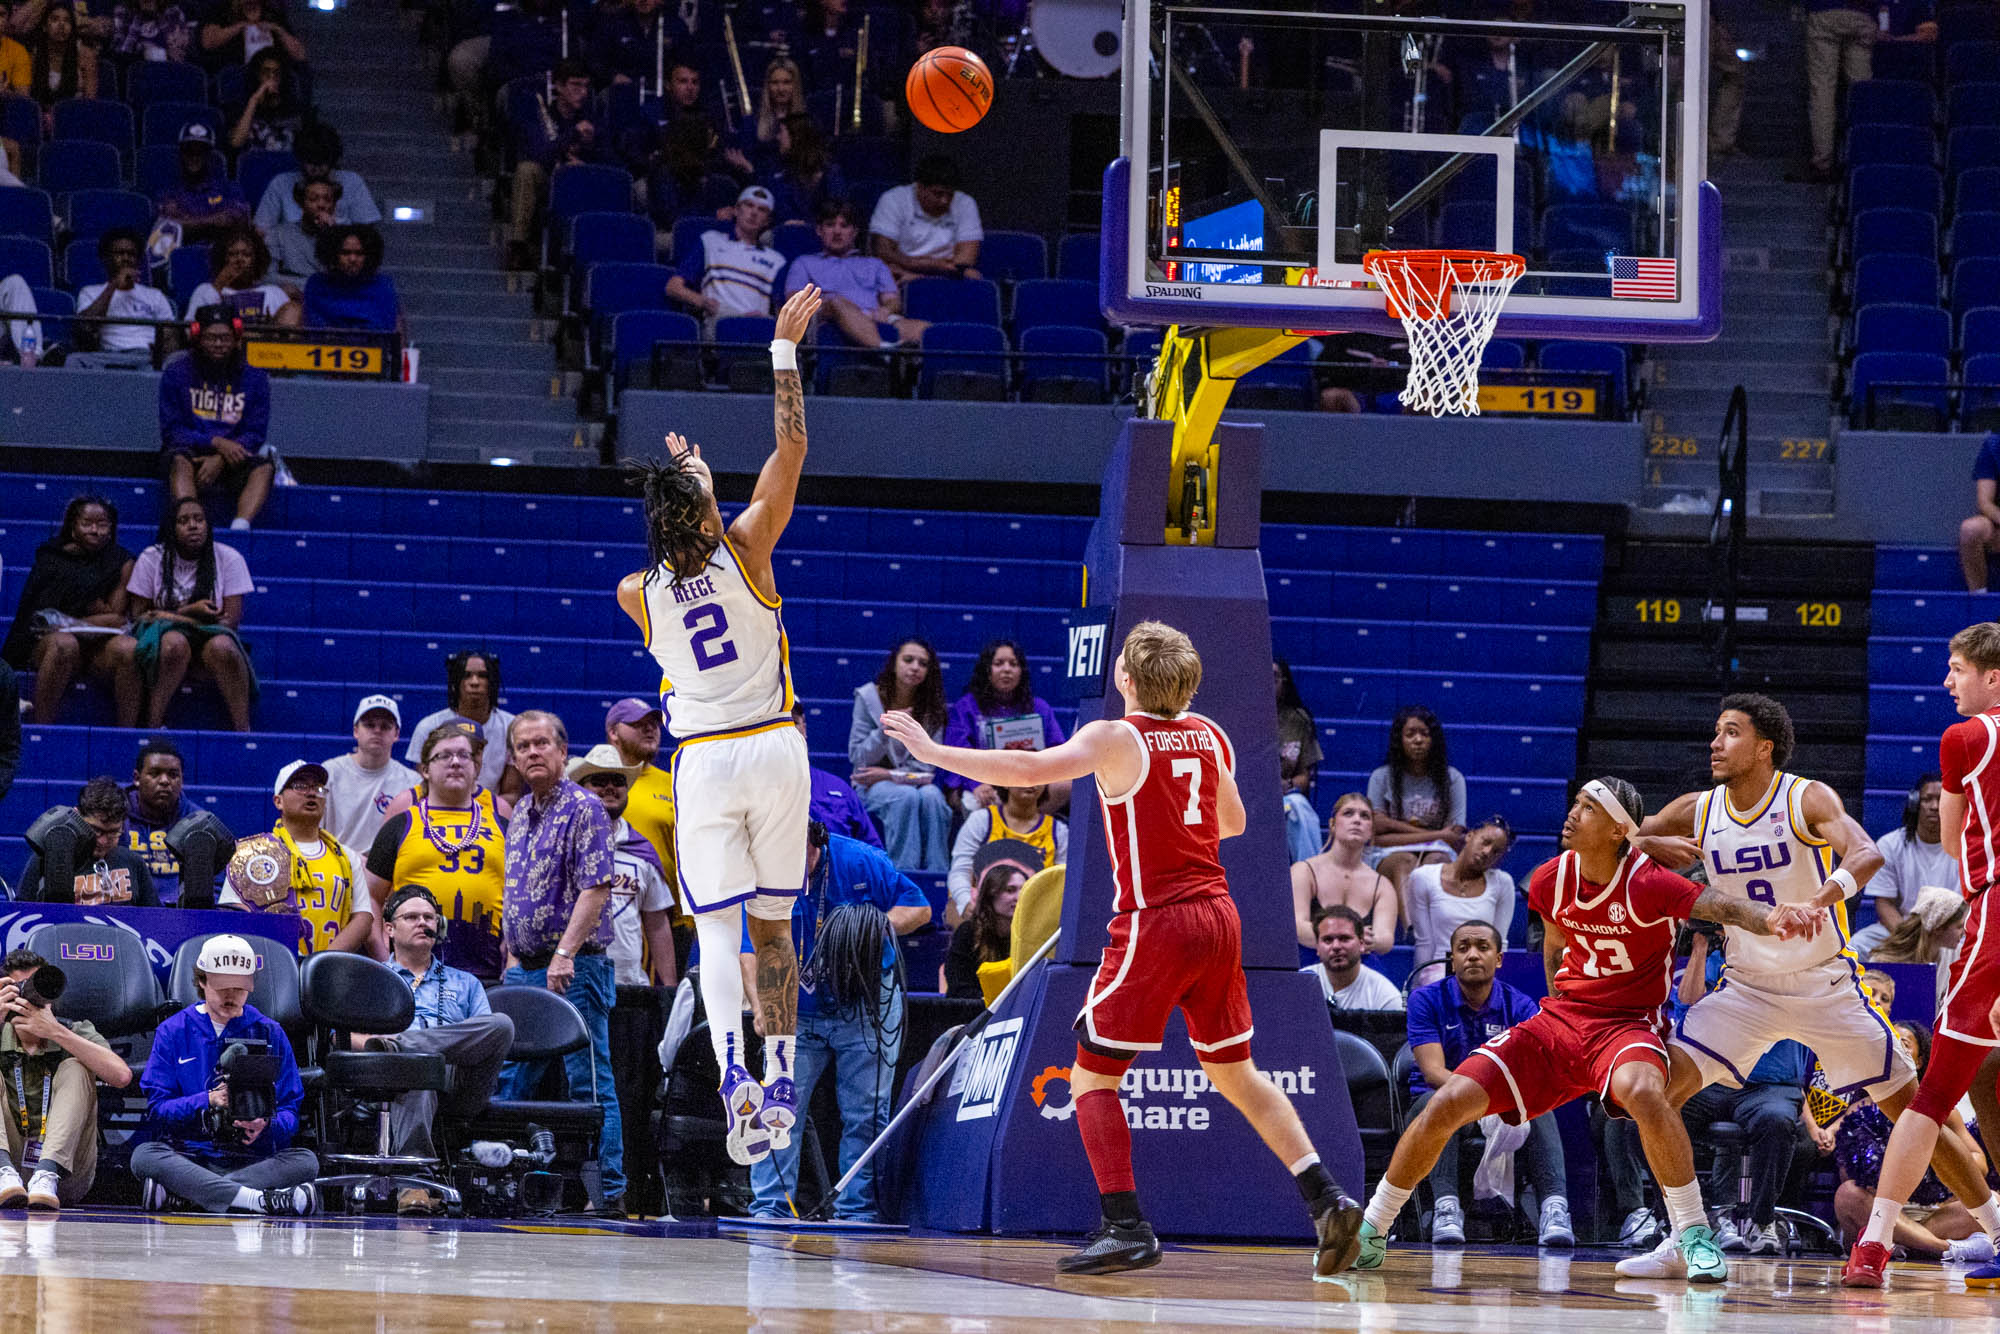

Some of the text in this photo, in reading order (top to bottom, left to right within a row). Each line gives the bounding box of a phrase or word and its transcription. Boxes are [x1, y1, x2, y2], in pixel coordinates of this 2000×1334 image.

[1145, 285, 1202, 299] SPALDING
[307, 349, 369, 369] 119
[189, 388, 245, 412] TIGERS
[1520, 390, 1584, 410] 119
[1651, 436, 1697, 455] 226
[1780, 440, 1827, 459] 227
[1635, 600, 1681, 622] 119
[1795, 603, 1842, 626] 120
[683, 602, 738, 672] 2
[1068, 624, 1106, 677] YETI
[1144, 729, 1214, 752] FORSYTHE
[1171, 758, 1203, 825] 7
[128, 830, 168, 850] LS
[438, 844, 486, 874] 33
[1711, 842, 1791, 874] LSU
[1609, 903, 1626, 922] SEC
[1561, 917, 1632, 935] OKLAHOMA
[61, 943, 114, 960] LSU
[213, 955, 251, 970] GEAUX
[1574, 934, 1634, 977] 13
[1119, 1099, 1209, 1130] hare
